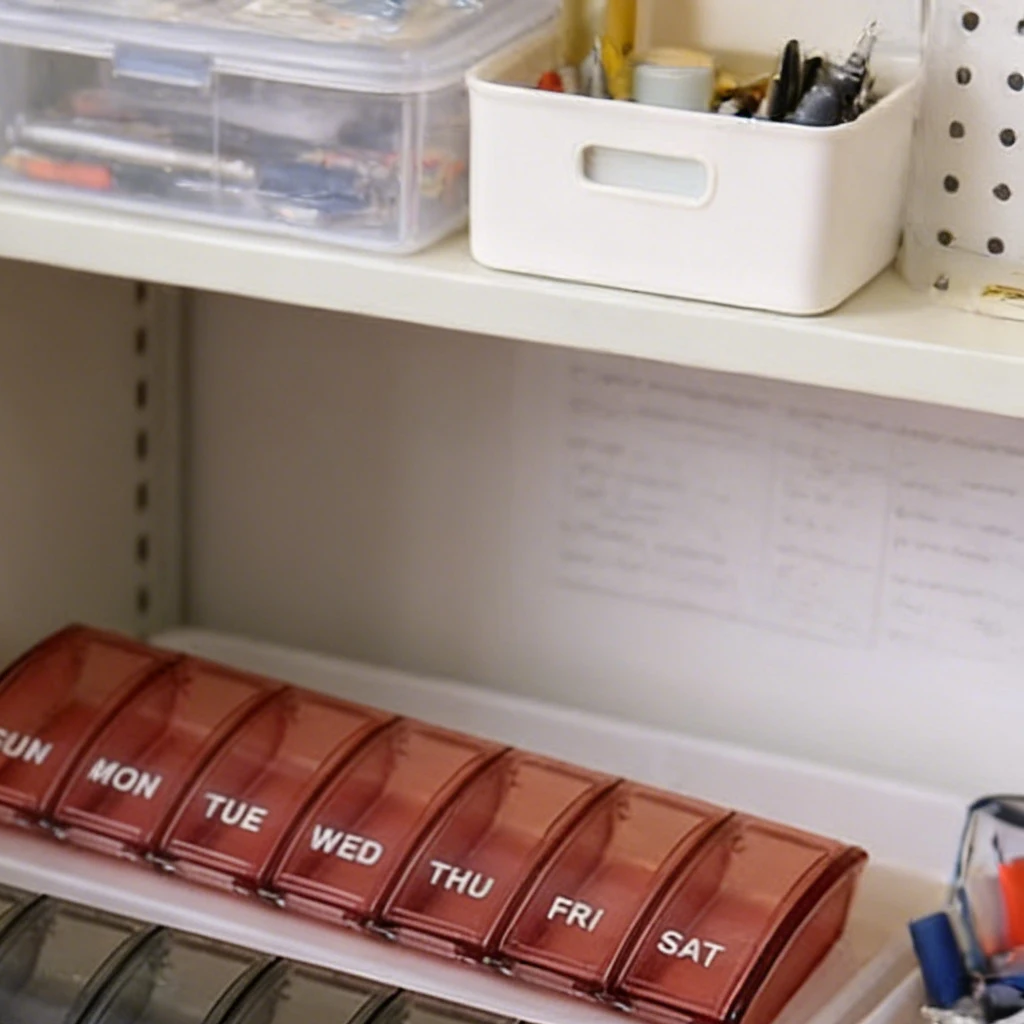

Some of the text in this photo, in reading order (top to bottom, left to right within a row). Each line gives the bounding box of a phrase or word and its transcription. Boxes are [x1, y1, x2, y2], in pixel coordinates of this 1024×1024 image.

[87, 757, 162, 799] MON
[204, 791, 269, 832] TUE
[310, 824, 383, 866] WED
[428, 860, 495, 900] THU
[546, 896, 604, 932] FRI
[656, 930, 725, 968] SAT
